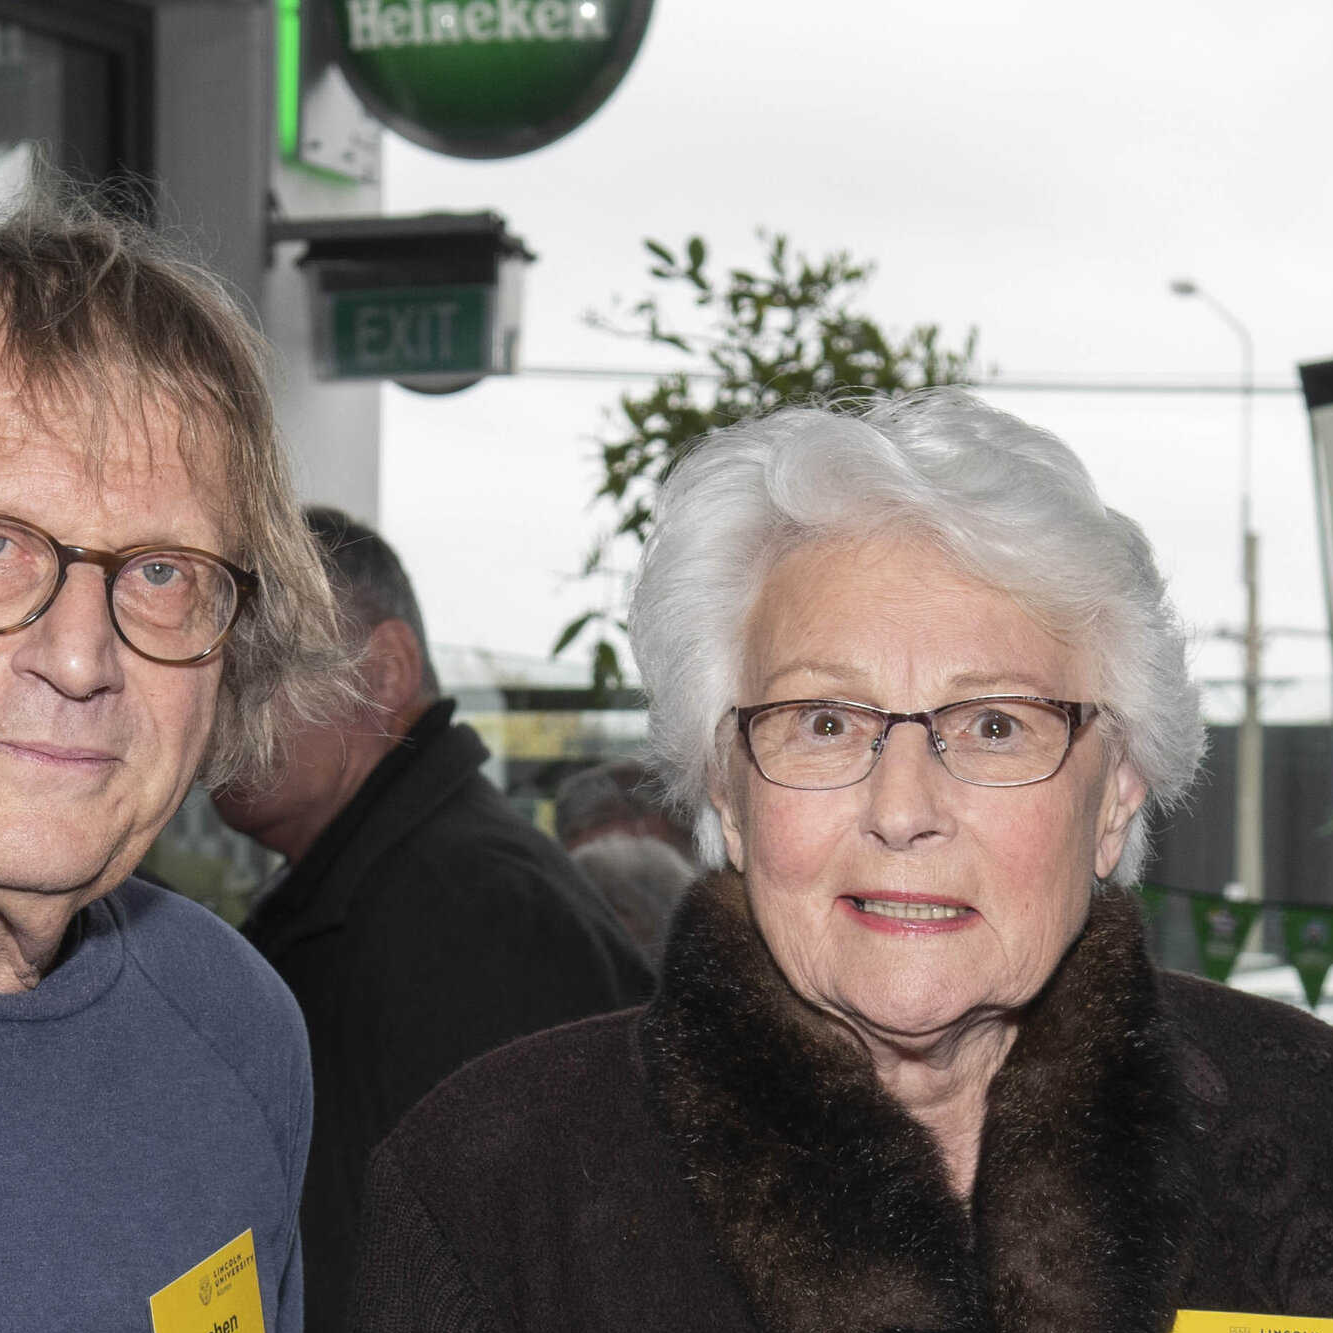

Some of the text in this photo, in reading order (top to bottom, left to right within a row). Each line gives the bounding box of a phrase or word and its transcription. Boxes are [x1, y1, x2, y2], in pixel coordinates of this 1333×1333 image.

[348, 0, 609, 51] Heineken
[354, 304, 457, 362] EXIT
[213, 1253, 241, 1277] LINCOLN
[215, 1254, 254, 1287] UNIVERSITY
